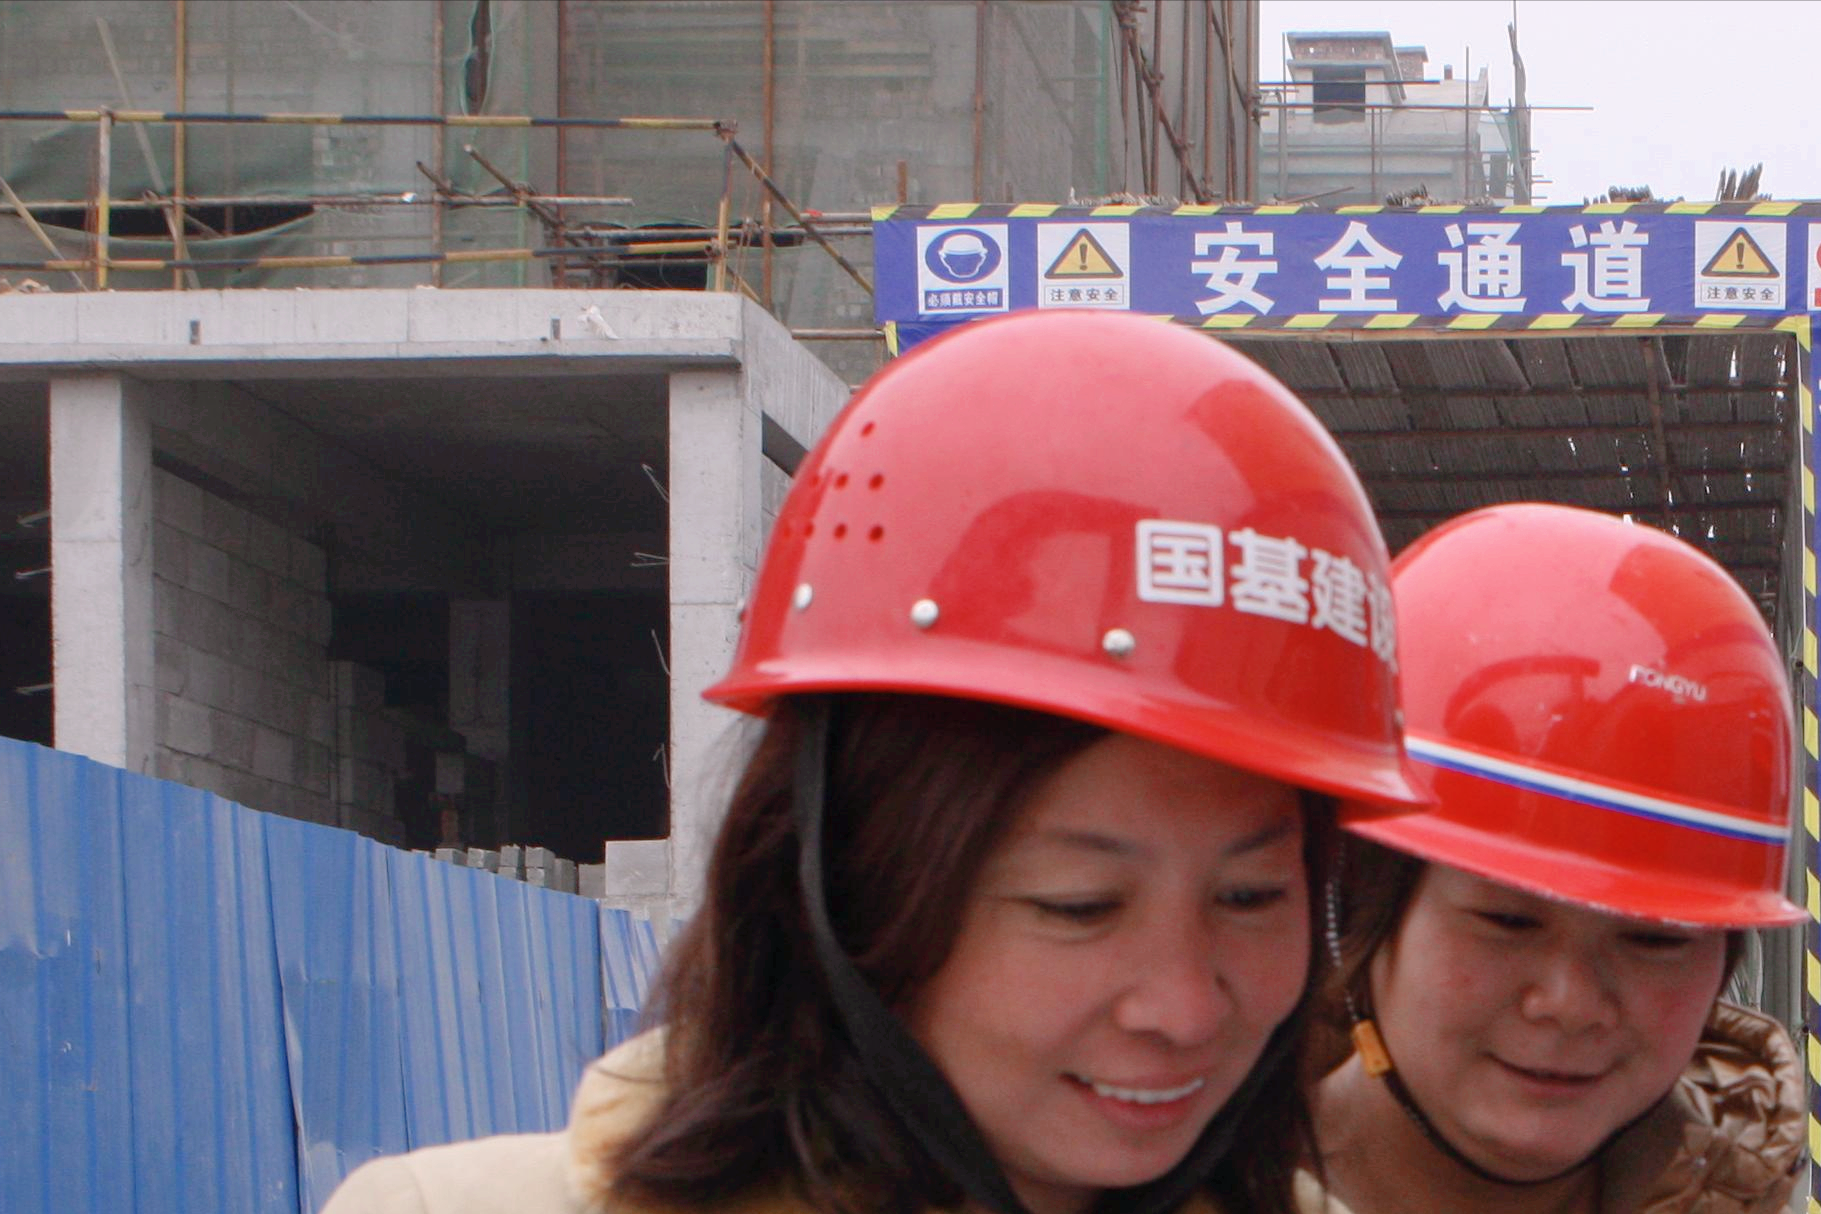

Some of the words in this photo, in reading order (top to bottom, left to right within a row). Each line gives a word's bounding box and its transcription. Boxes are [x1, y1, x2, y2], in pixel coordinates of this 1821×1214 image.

[1191, 220, 1652, 315] 安全通道
[1050, 287, 1119, 302] 注意安全
[1706, 286, 1775, 302] 注意安全
